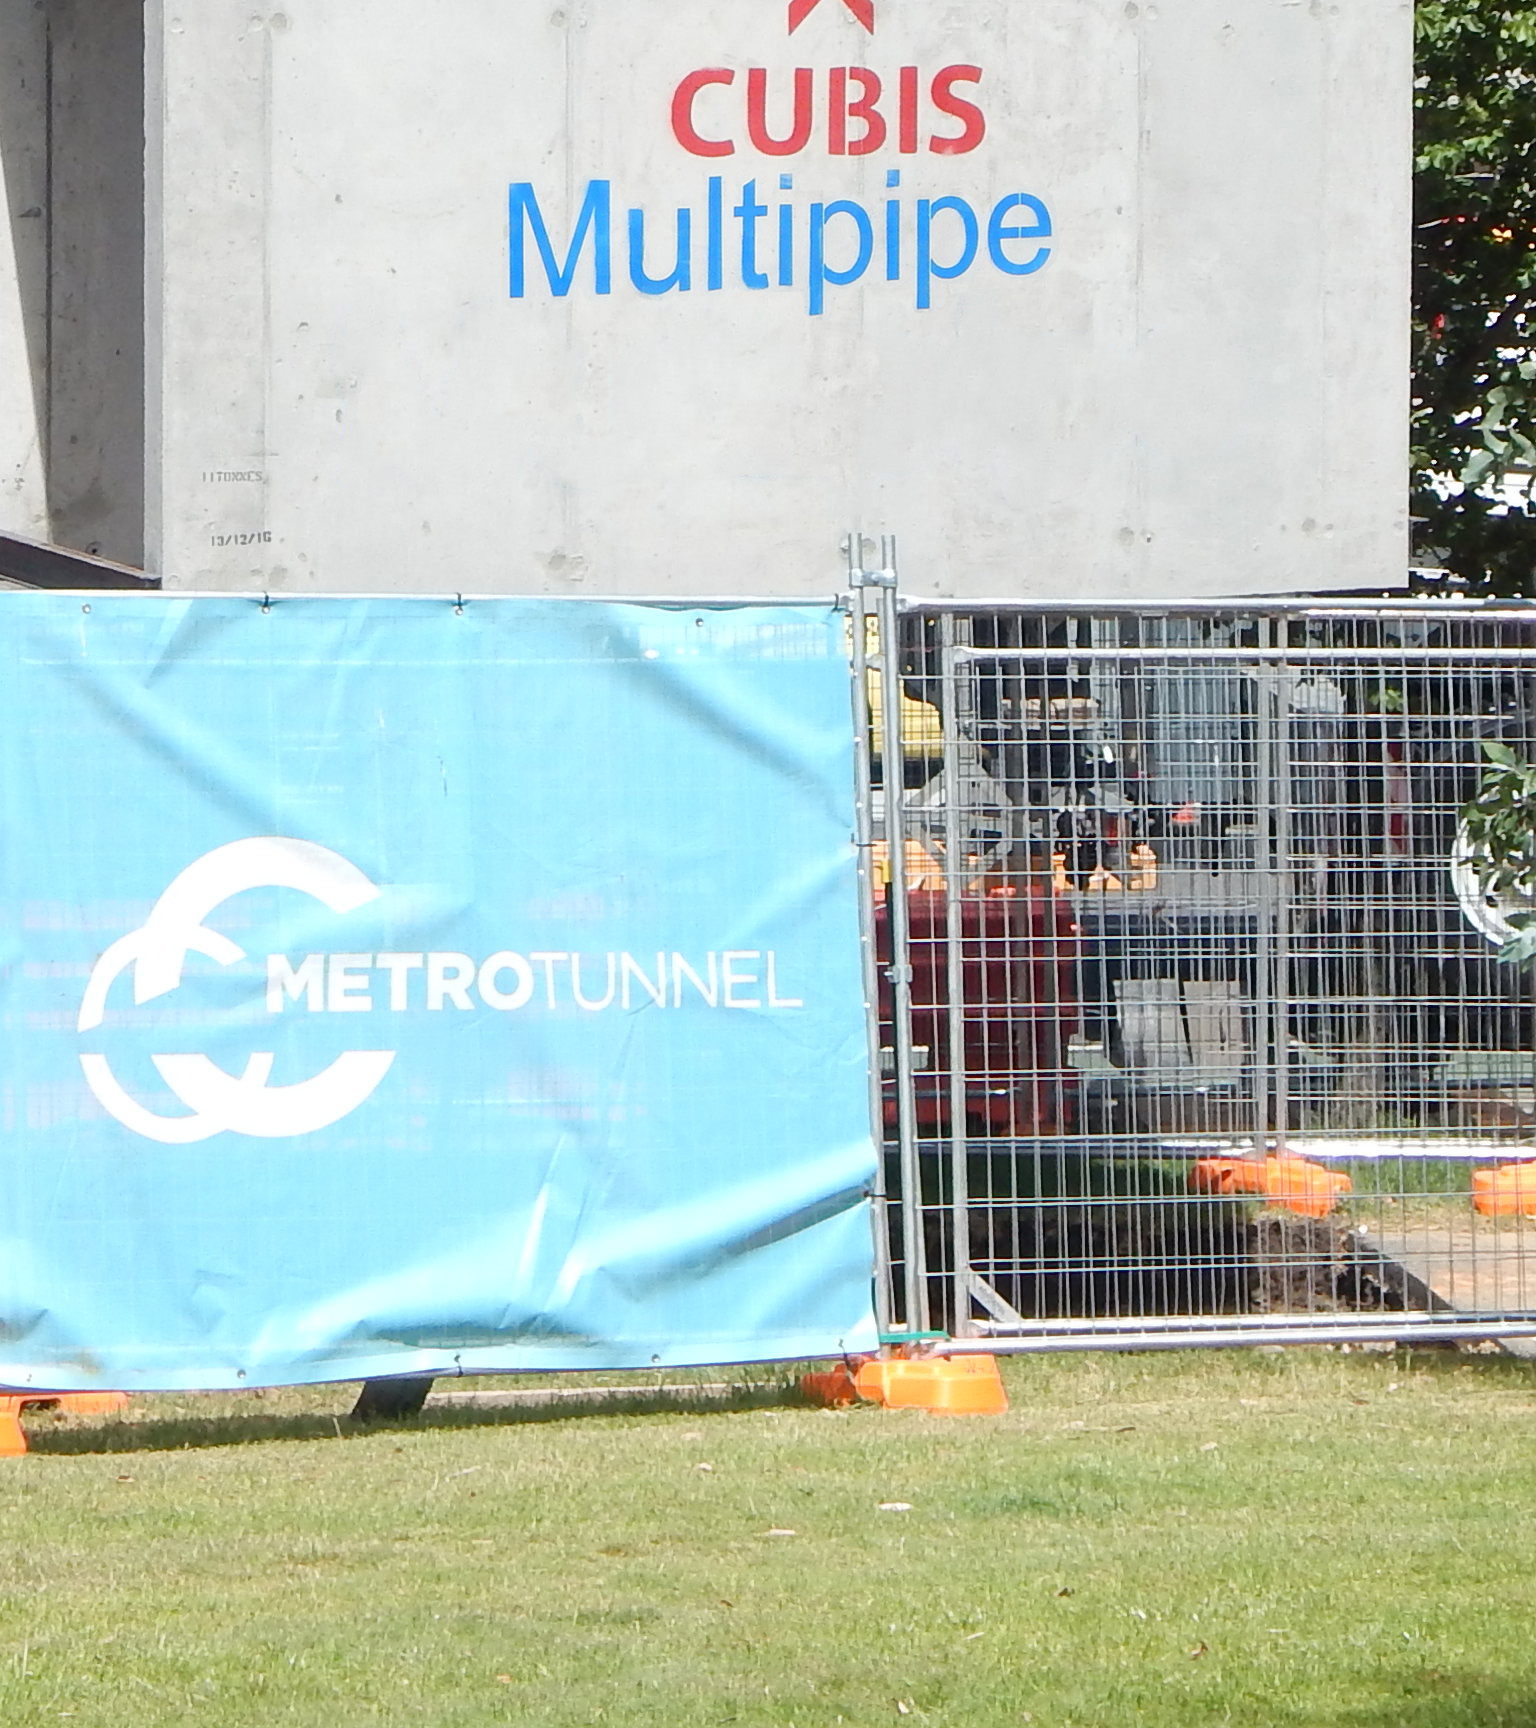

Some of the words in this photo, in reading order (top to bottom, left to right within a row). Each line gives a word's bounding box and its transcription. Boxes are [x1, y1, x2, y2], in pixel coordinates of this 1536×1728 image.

[670, 64, 987, 157] CUBIS
[508, 168, 1053, 316] Multipipe
[211, 531, 272, 547] 13/12/16
[266, 949, 804, 1013] METROTUNNEL
